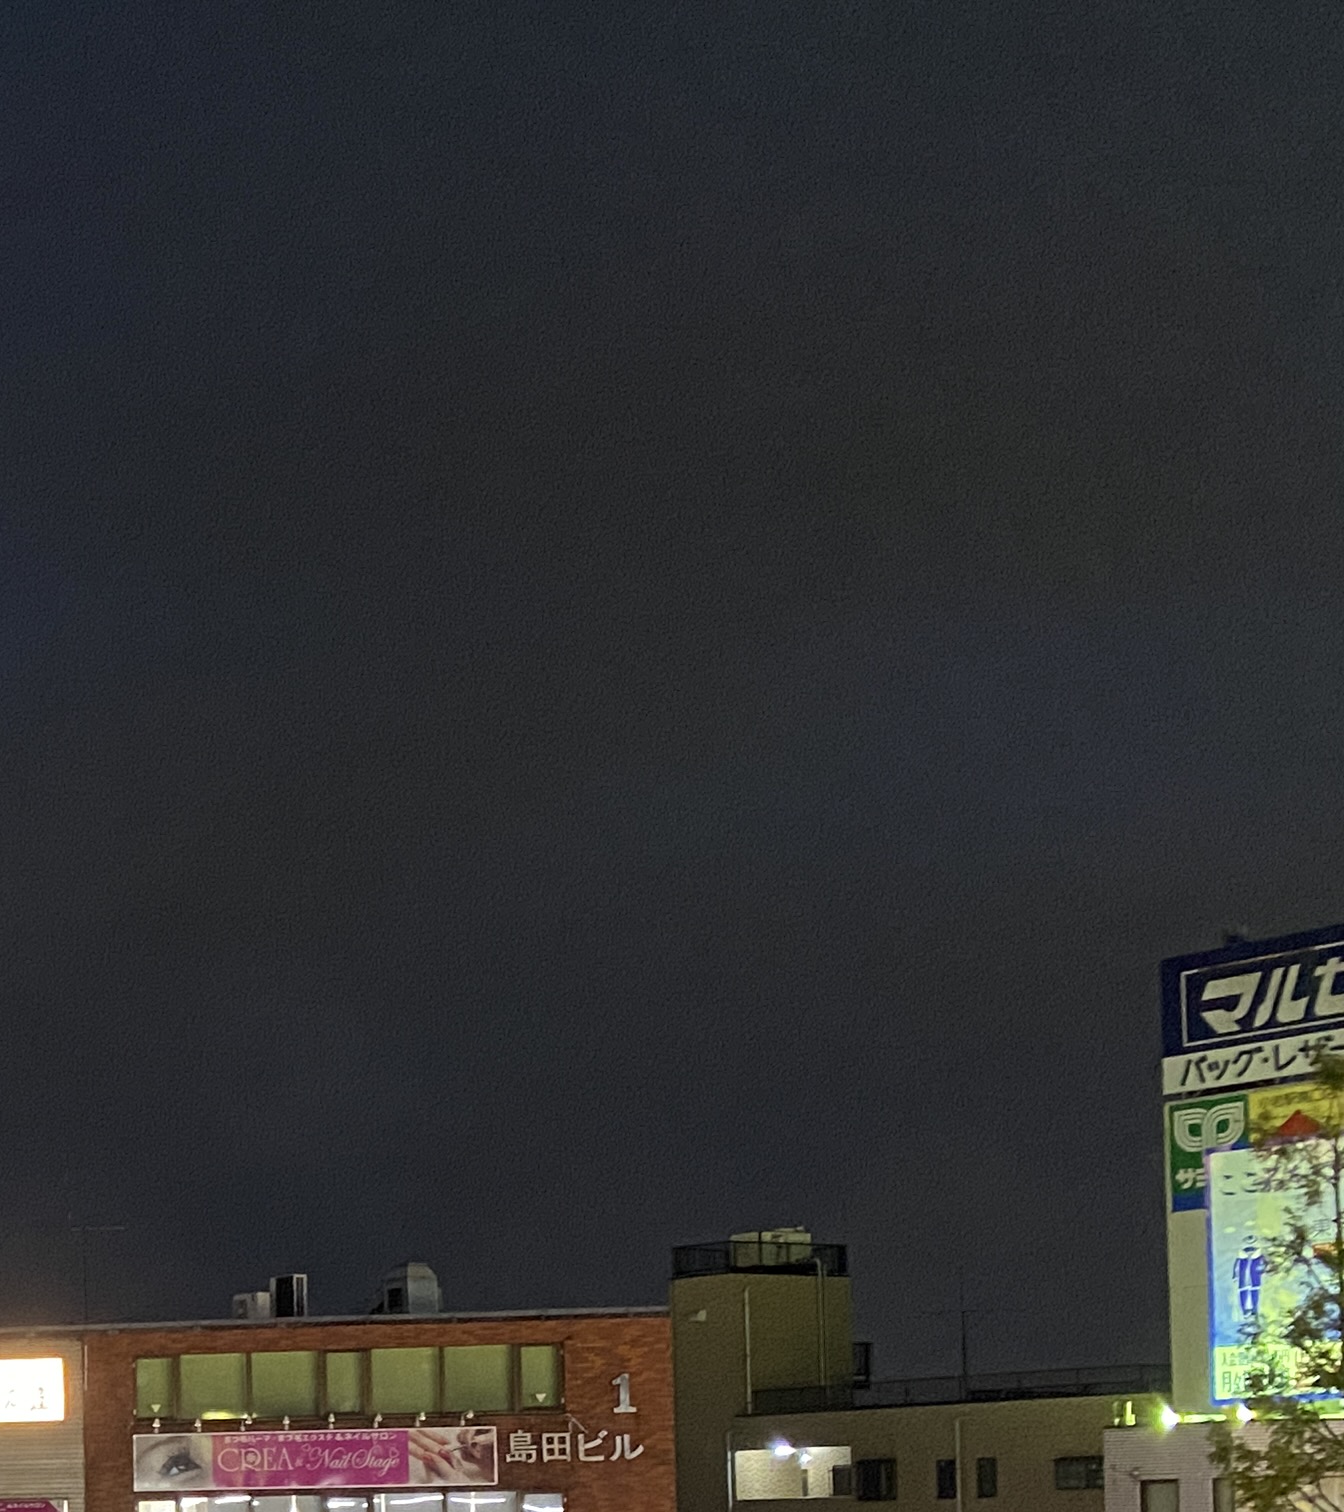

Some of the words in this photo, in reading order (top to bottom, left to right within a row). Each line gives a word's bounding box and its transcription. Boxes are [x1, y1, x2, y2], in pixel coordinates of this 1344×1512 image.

[218, 1448, 294, 1472] CREA
[506, 1429, 644, 1463] 島田ビル
